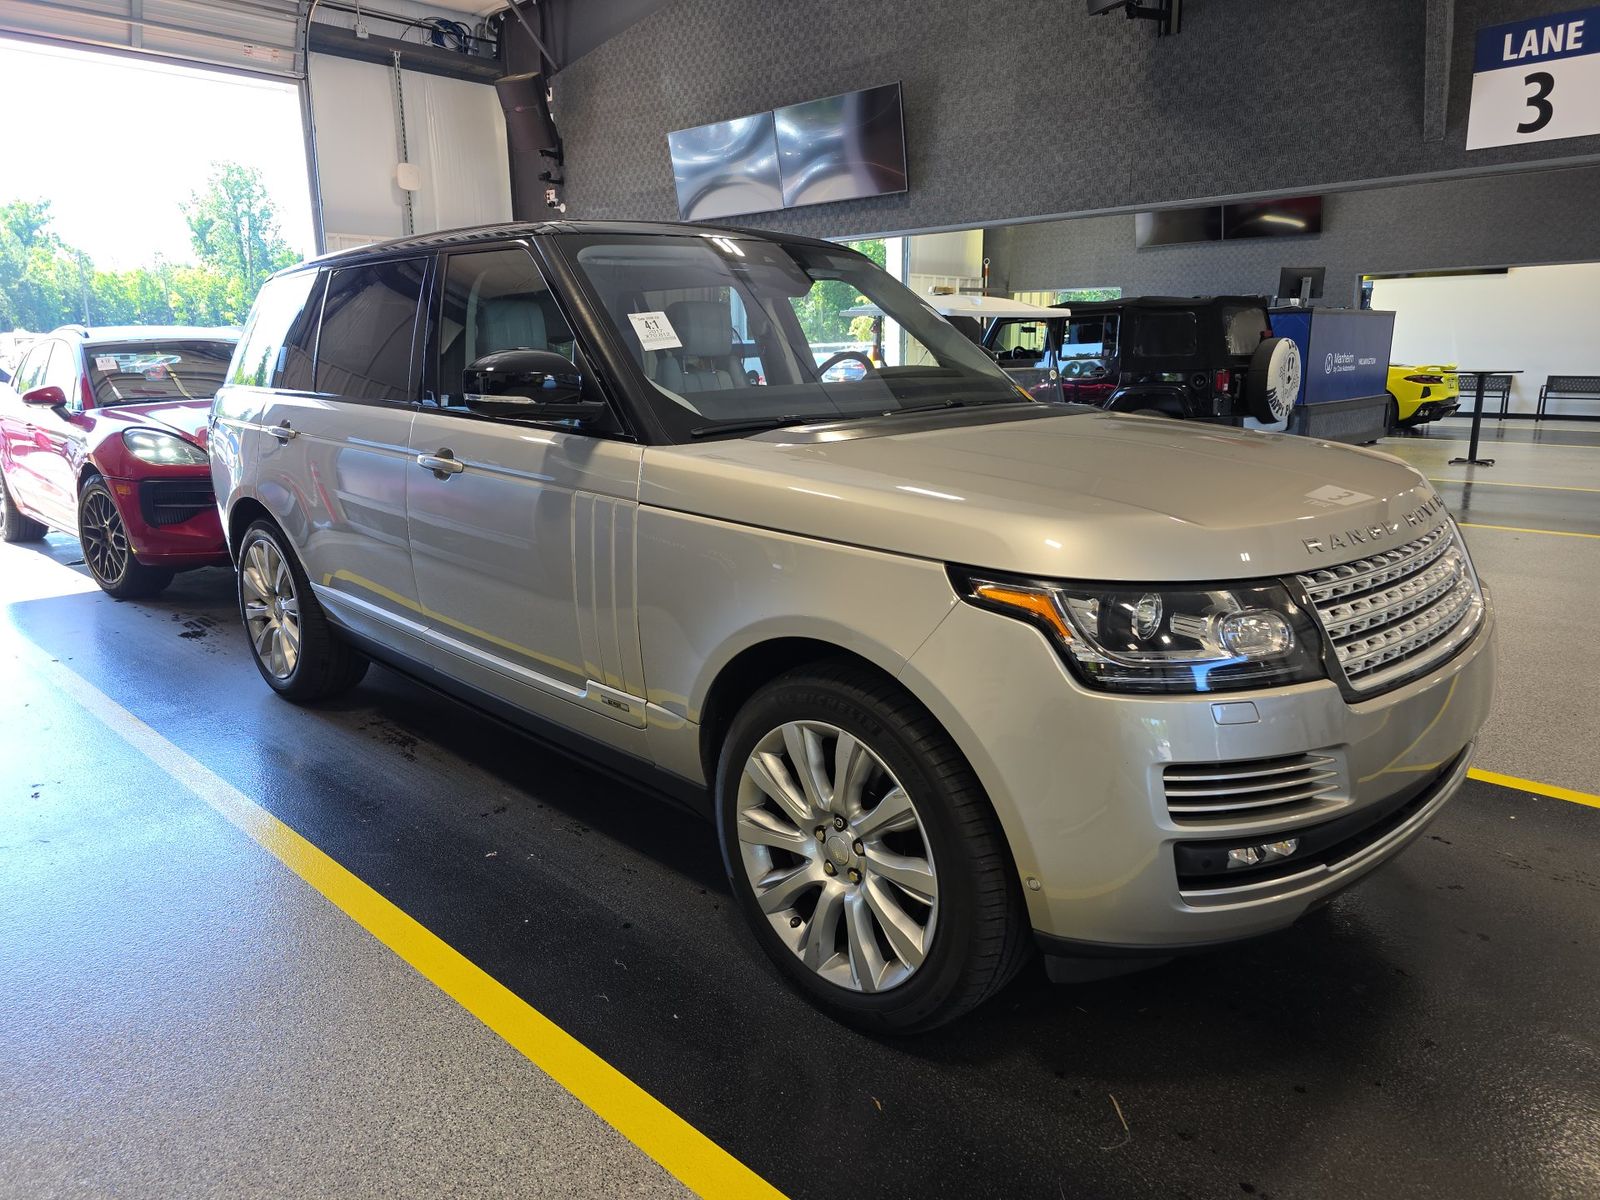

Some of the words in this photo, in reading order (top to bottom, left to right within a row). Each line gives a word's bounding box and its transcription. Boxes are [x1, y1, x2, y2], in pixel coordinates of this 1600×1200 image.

[1502, 20, 1585, 61] LANE
[1516, 71, 1555, 134] 3
[644, 320, 660, 330] 4:1
[1301, 520, 1399, 555] RANGE
